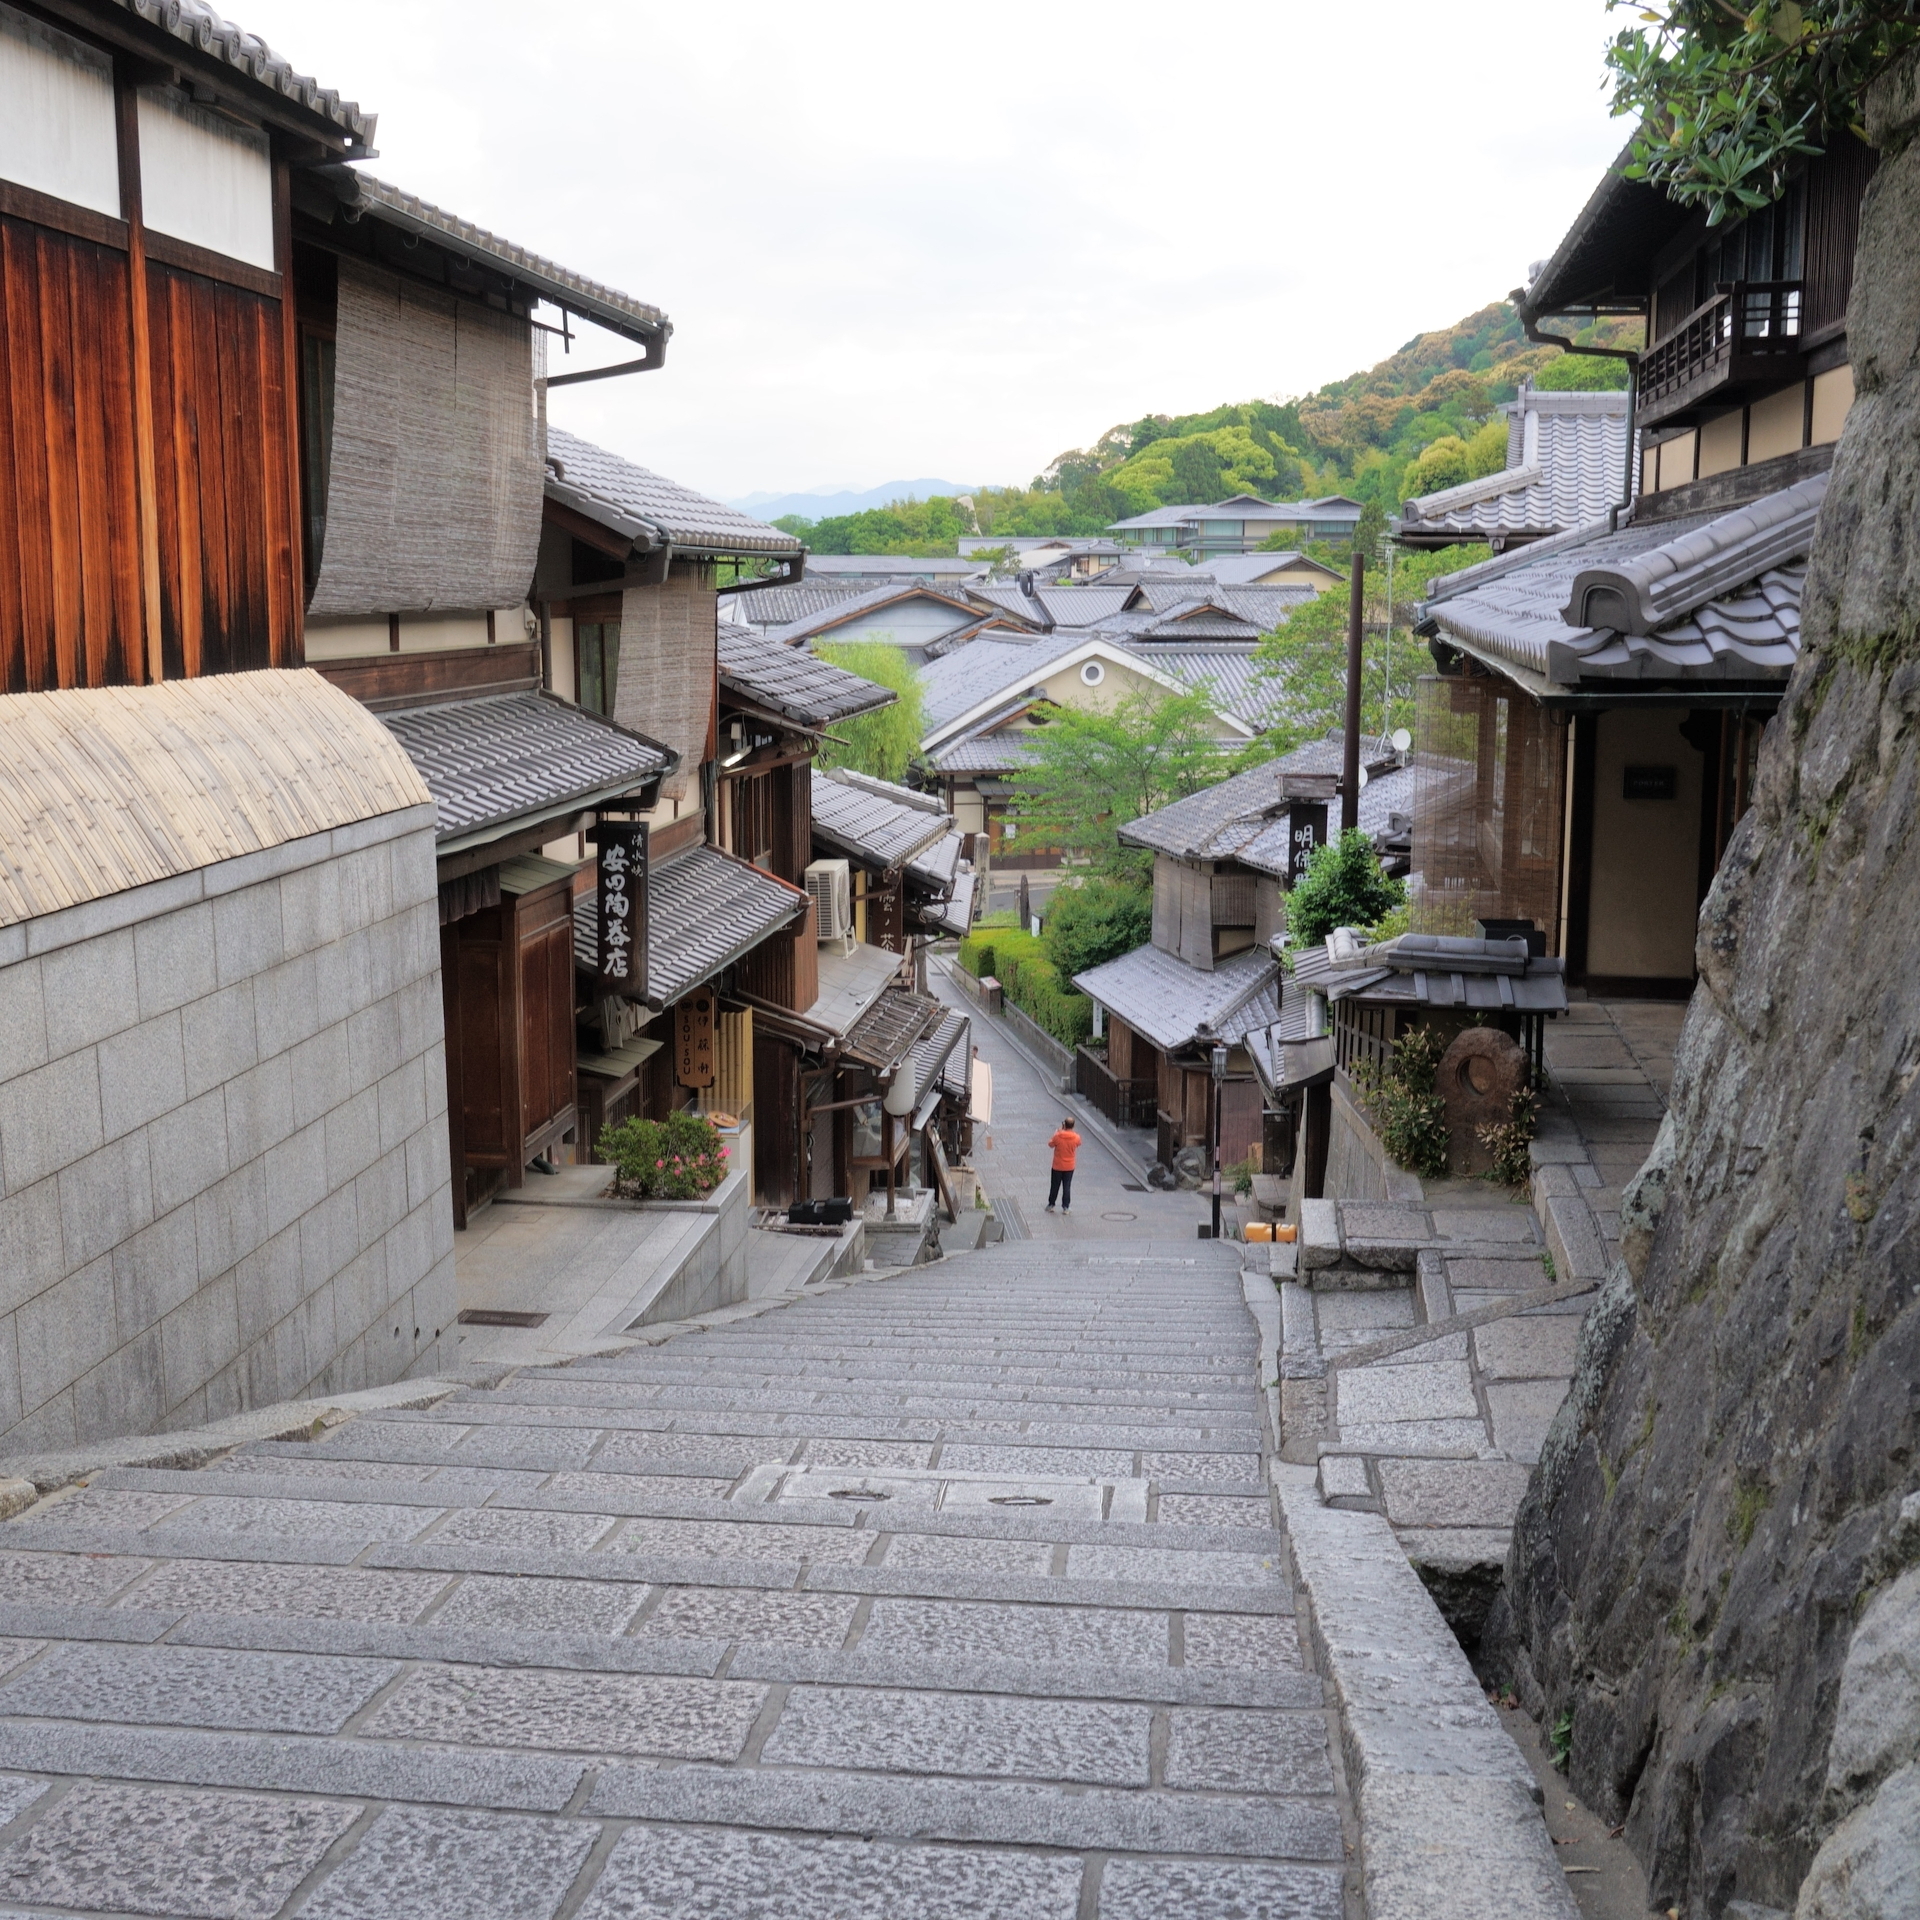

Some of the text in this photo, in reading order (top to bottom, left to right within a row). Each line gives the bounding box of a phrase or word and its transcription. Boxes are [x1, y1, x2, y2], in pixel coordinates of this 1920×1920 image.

[631, 834, 646, 877] 清水焼
[602, 843, 631, 978] 安田陶器店
